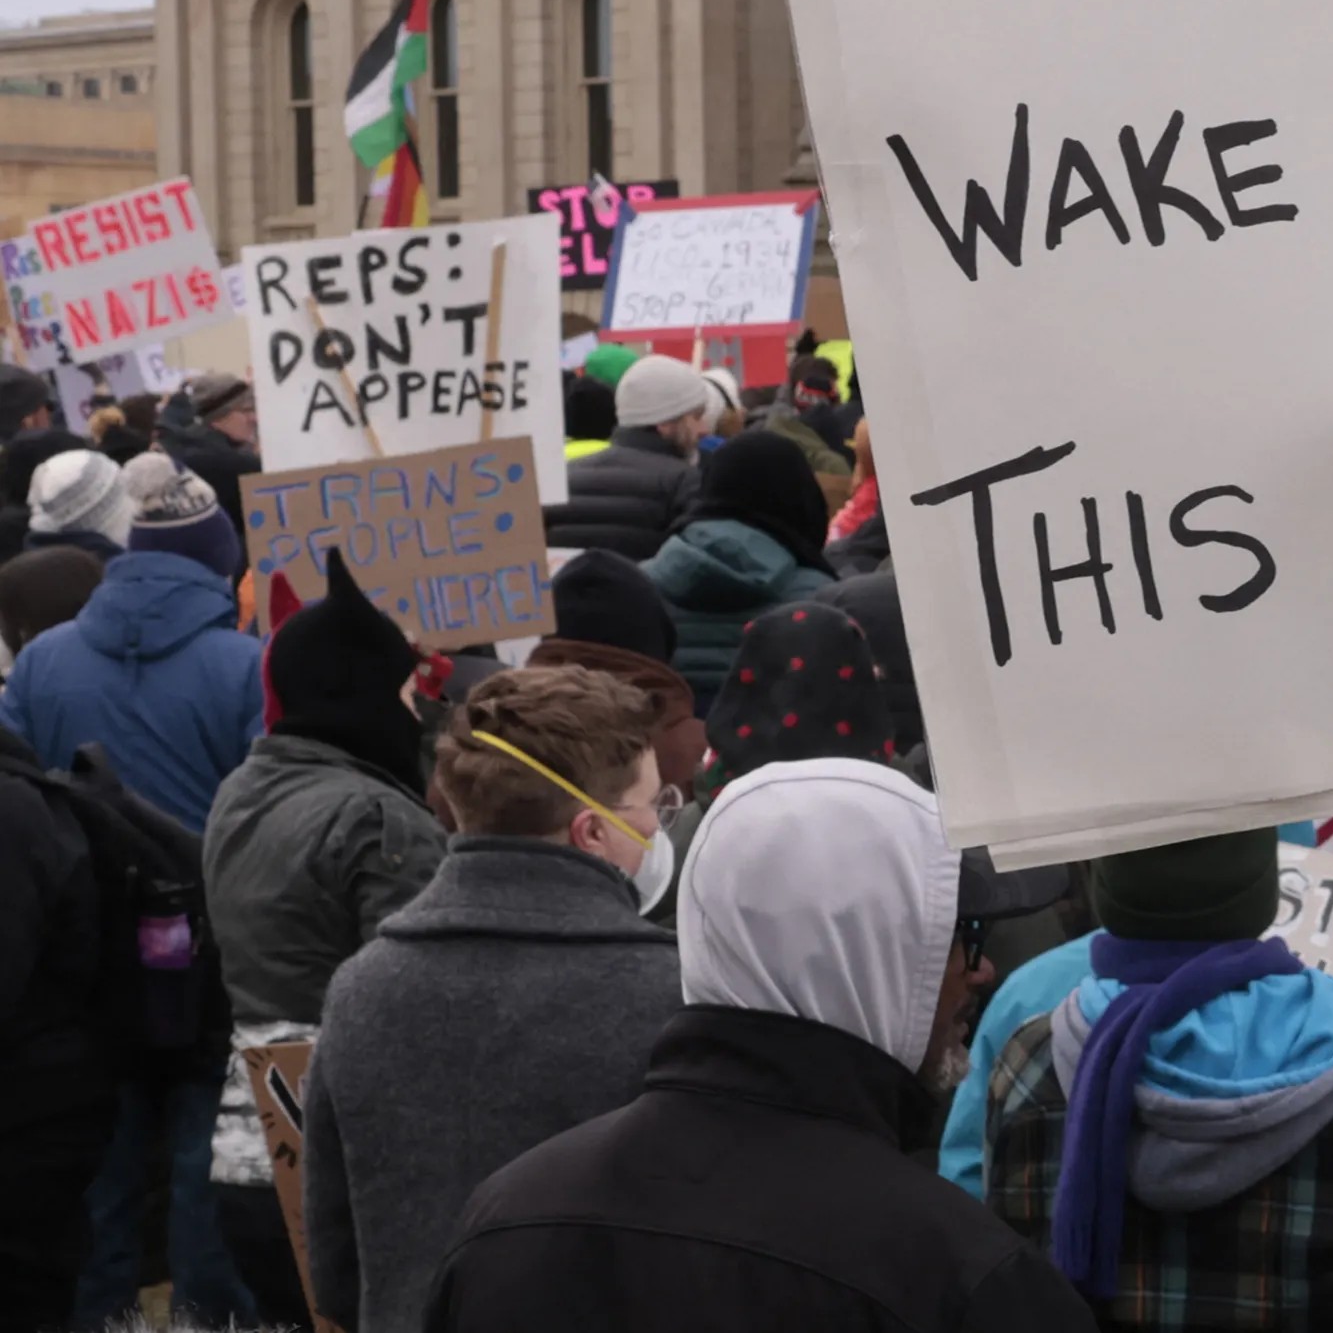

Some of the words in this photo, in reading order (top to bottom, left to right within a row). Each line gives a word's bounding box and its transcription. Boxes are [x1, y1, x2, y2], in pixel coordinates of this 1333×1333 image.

[33, 181, 197, 272] RESIST
[885, 102, 1300, 283] WAKE
[255, 232, 462, 316] REPS:
[268, 302, 490, 386] DON'T
[301, 359, 530, 433] APPEASE
[252, 452, 504, 529] TRANS
[265, 510, 484, 576] PEOPLE
[909, 439, 1278, 668] THIS
